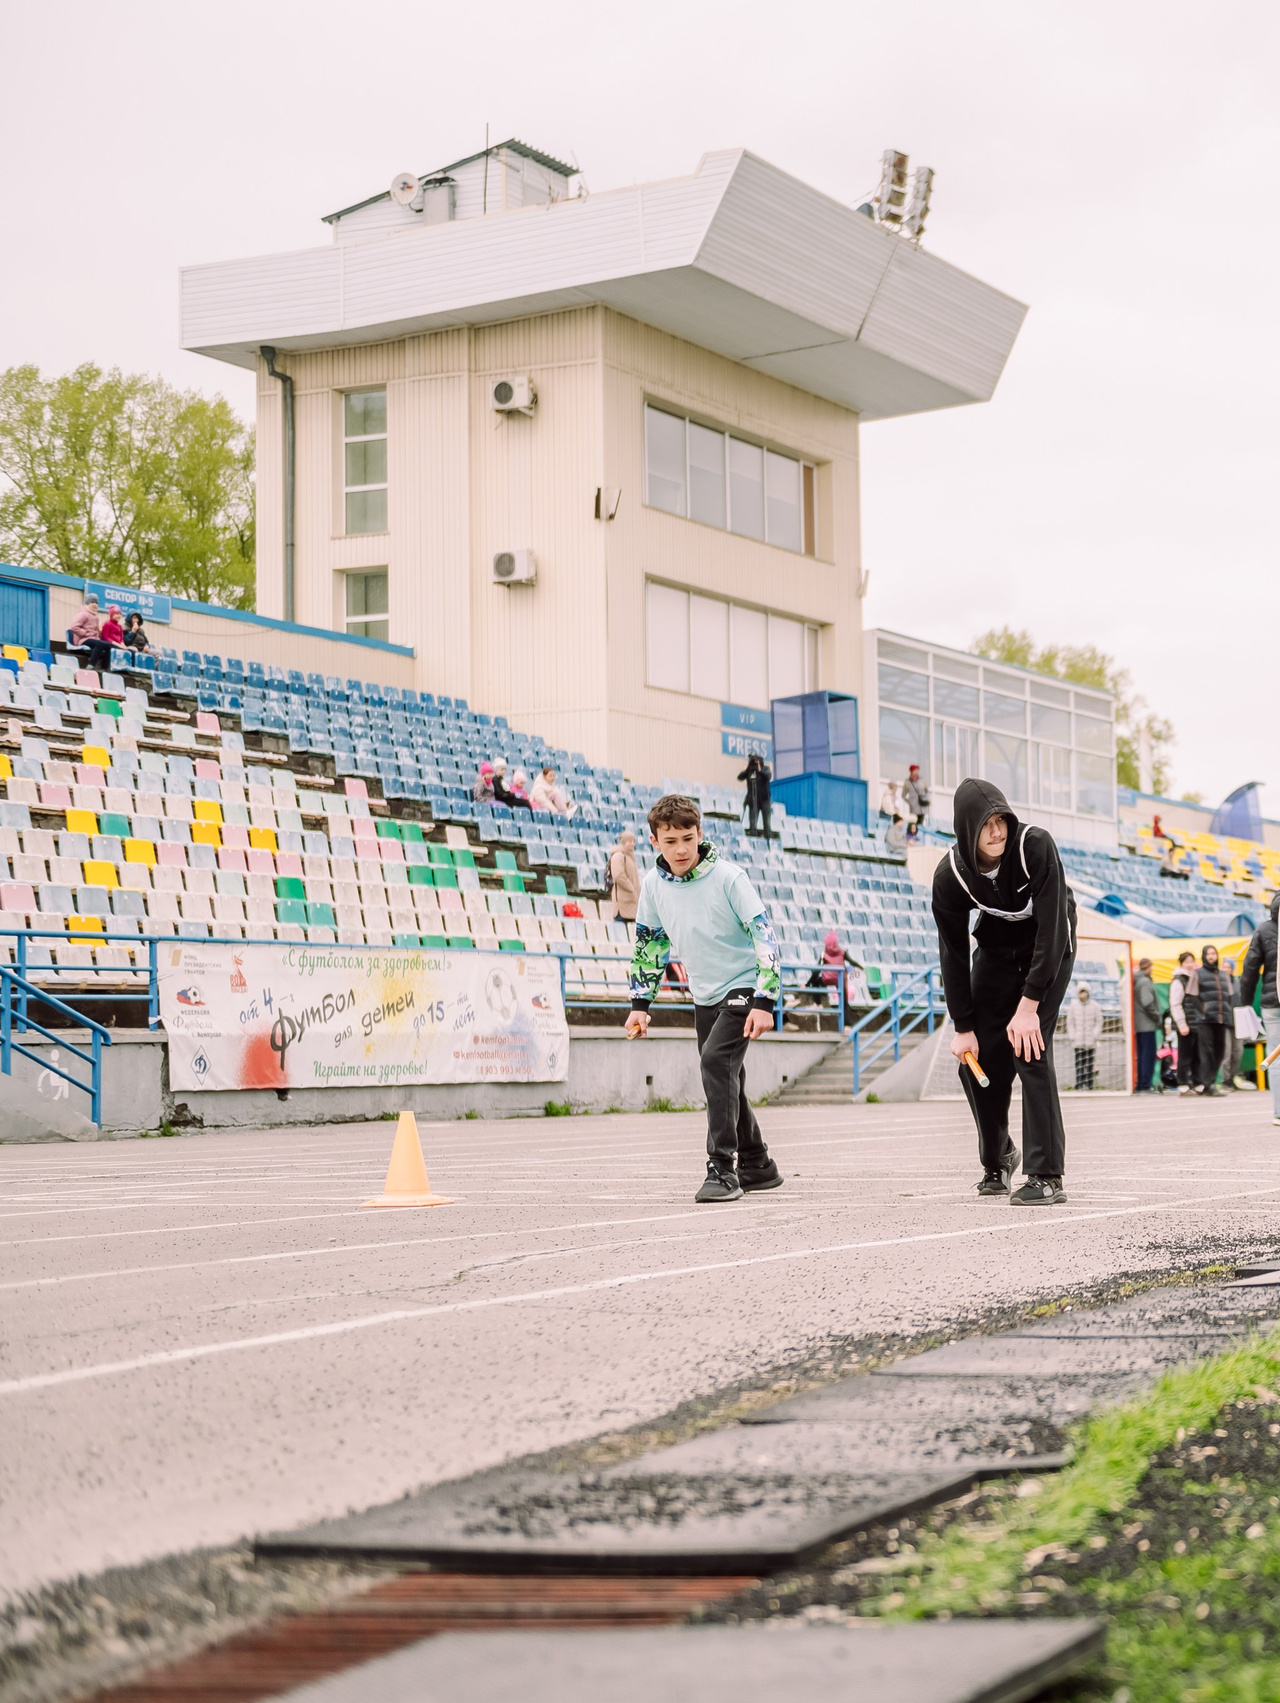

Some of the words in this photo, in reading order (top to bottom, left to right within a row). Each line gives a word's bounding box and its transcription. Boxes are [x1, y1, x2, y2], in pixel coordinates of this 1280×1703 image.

[105, 589, 137, 604] СЕКТОР
[739, 712, 755, 724] VIP
[728, 735, 768, 760] PRESS
[298, 950, 365, 976] футболом
[366, 958, 381, 978] за
[334, 1025, 353, 1048] для
[361, 991, 415, 1037] детей
[413, 1013, 426, 1040] до
[452, 1004, 476, 1031] лет
[313, 1060, 361, 1084] Играйте
[363, 1065, 377, 1076] на
[379, 1059, 428, 1084] здоровье!
